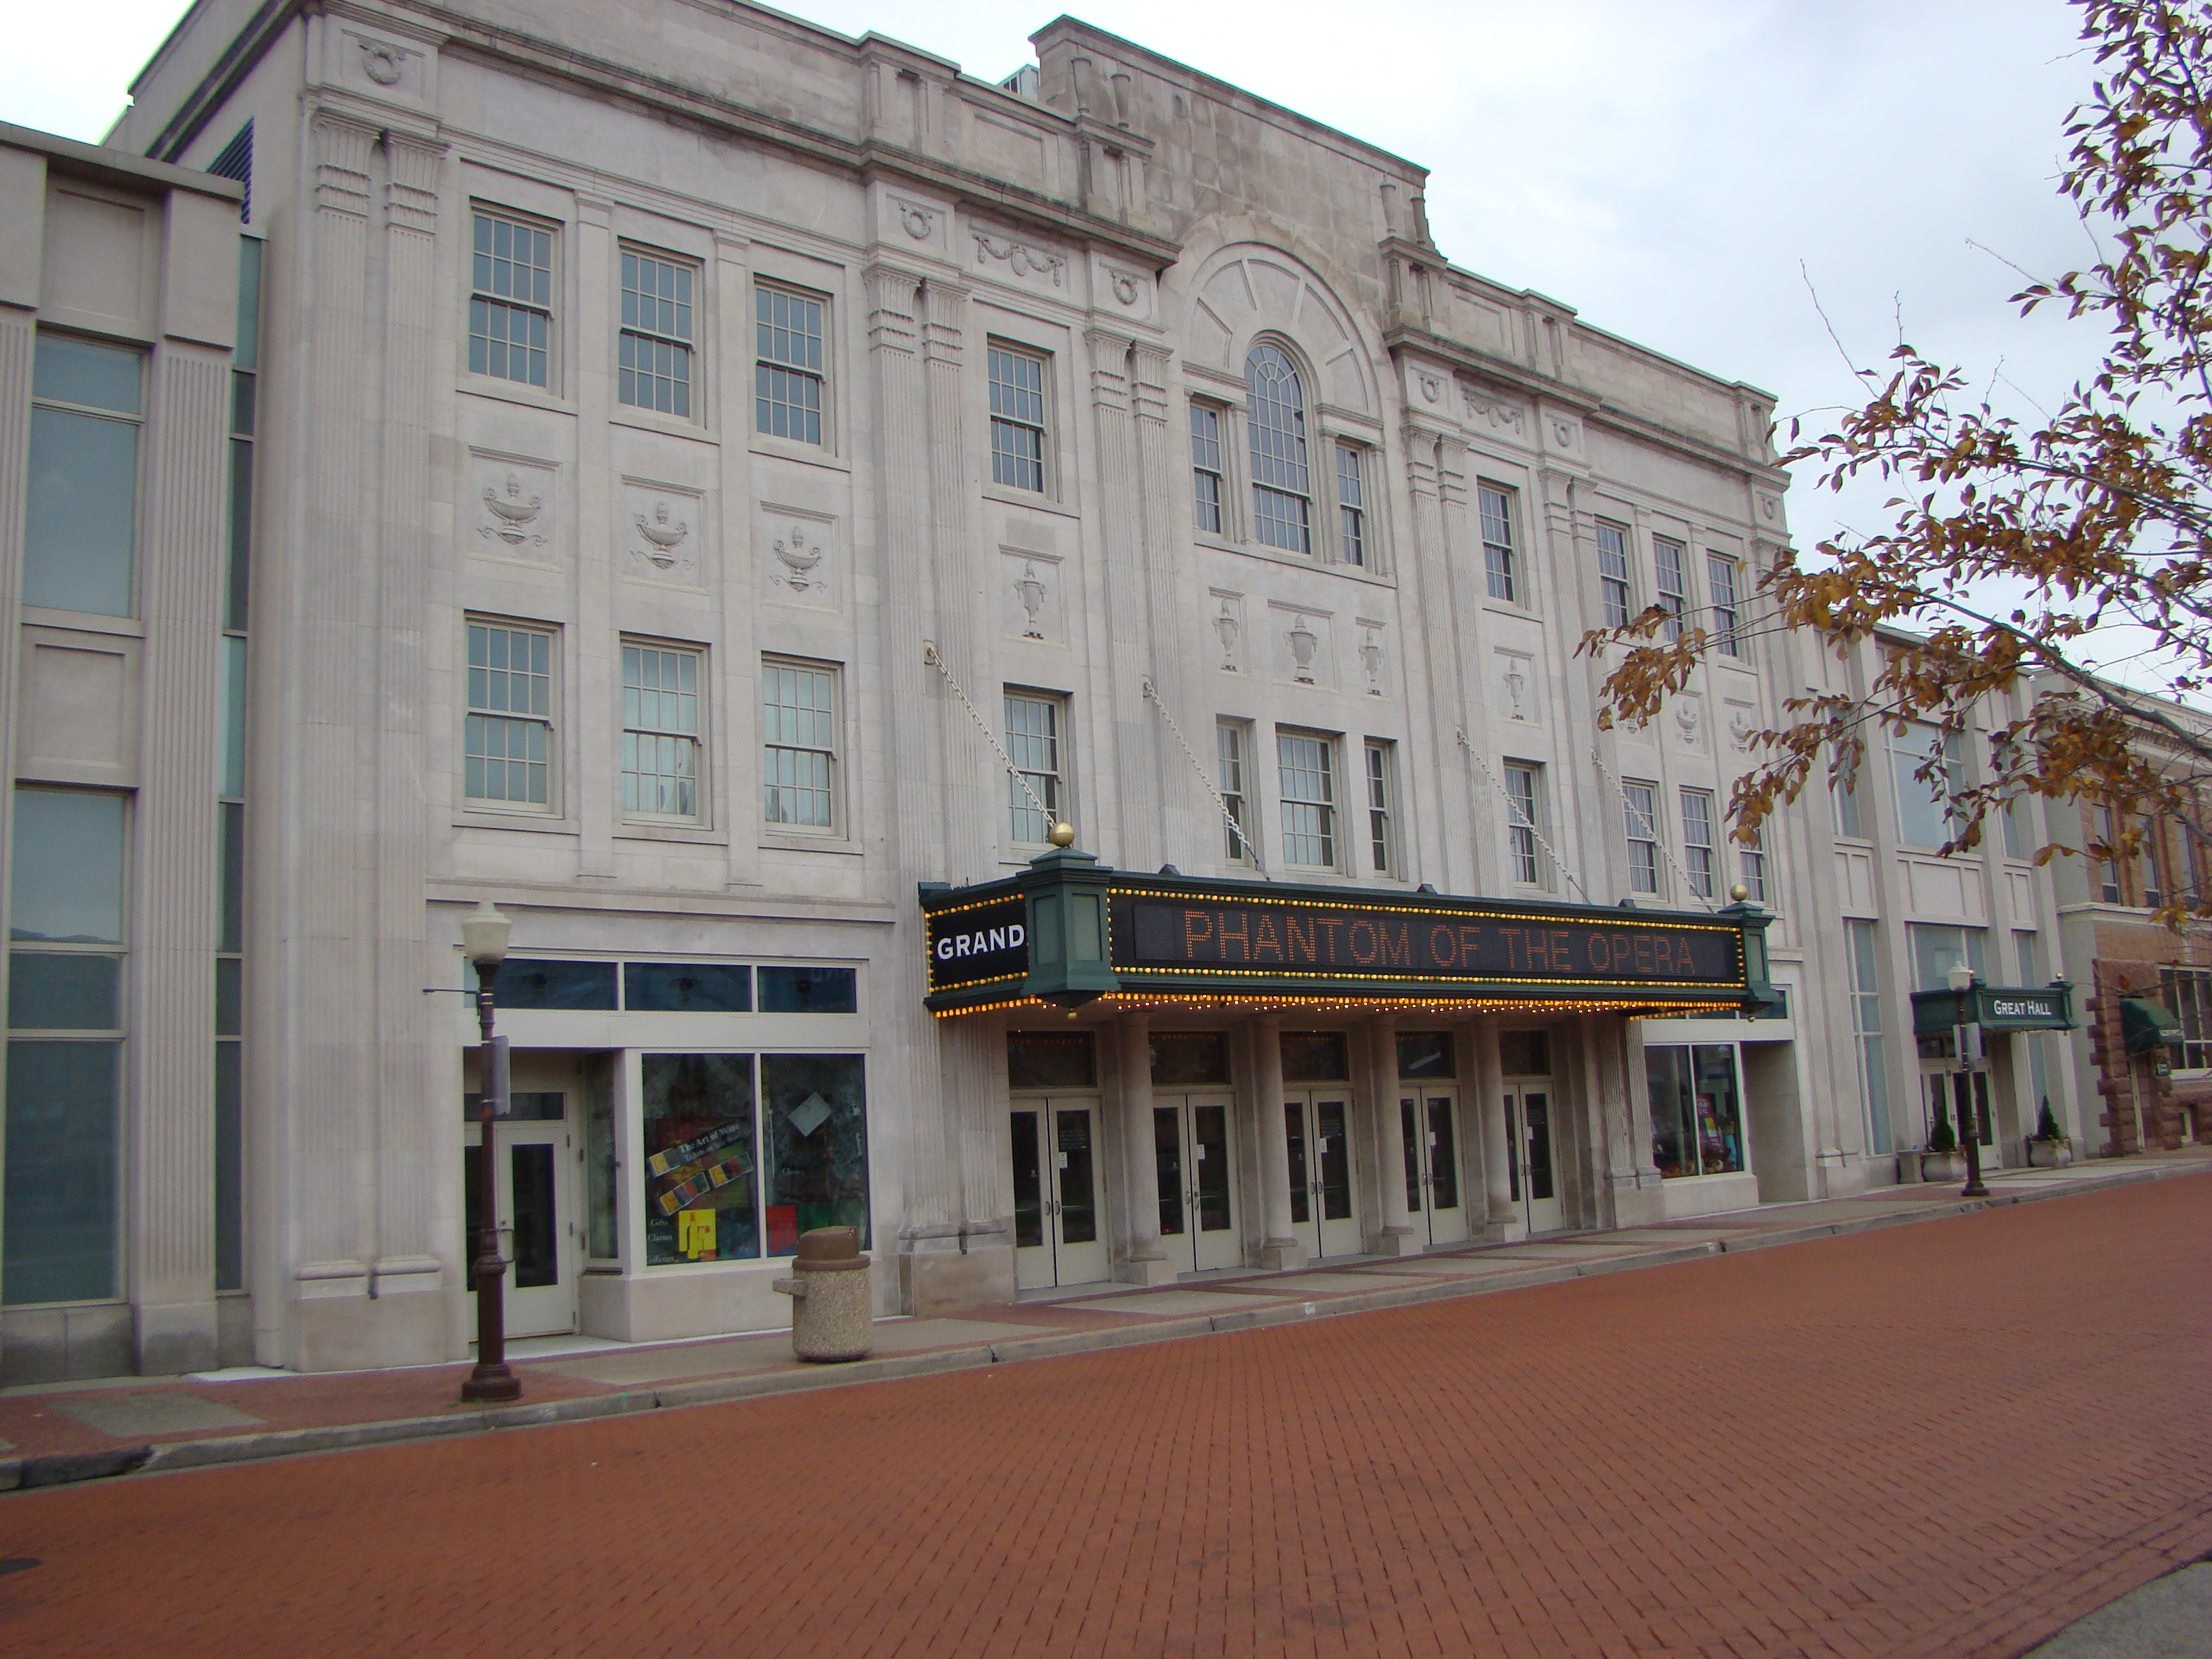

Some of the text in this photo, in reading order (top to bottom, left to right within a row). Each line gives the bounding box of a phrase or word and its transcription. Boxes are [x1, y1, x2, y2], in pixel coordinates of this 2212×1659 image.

[937, 923, 1025, 960] GRAND
[1184, 909, 1696, 975] PHANTOM OF THE OPERA
[1994, 1000, 2052, 1015] GREAT HALL
[680, 1123, 740, 1153] The Art of Wine
[650, 1218, 669, 1226] Gifts
